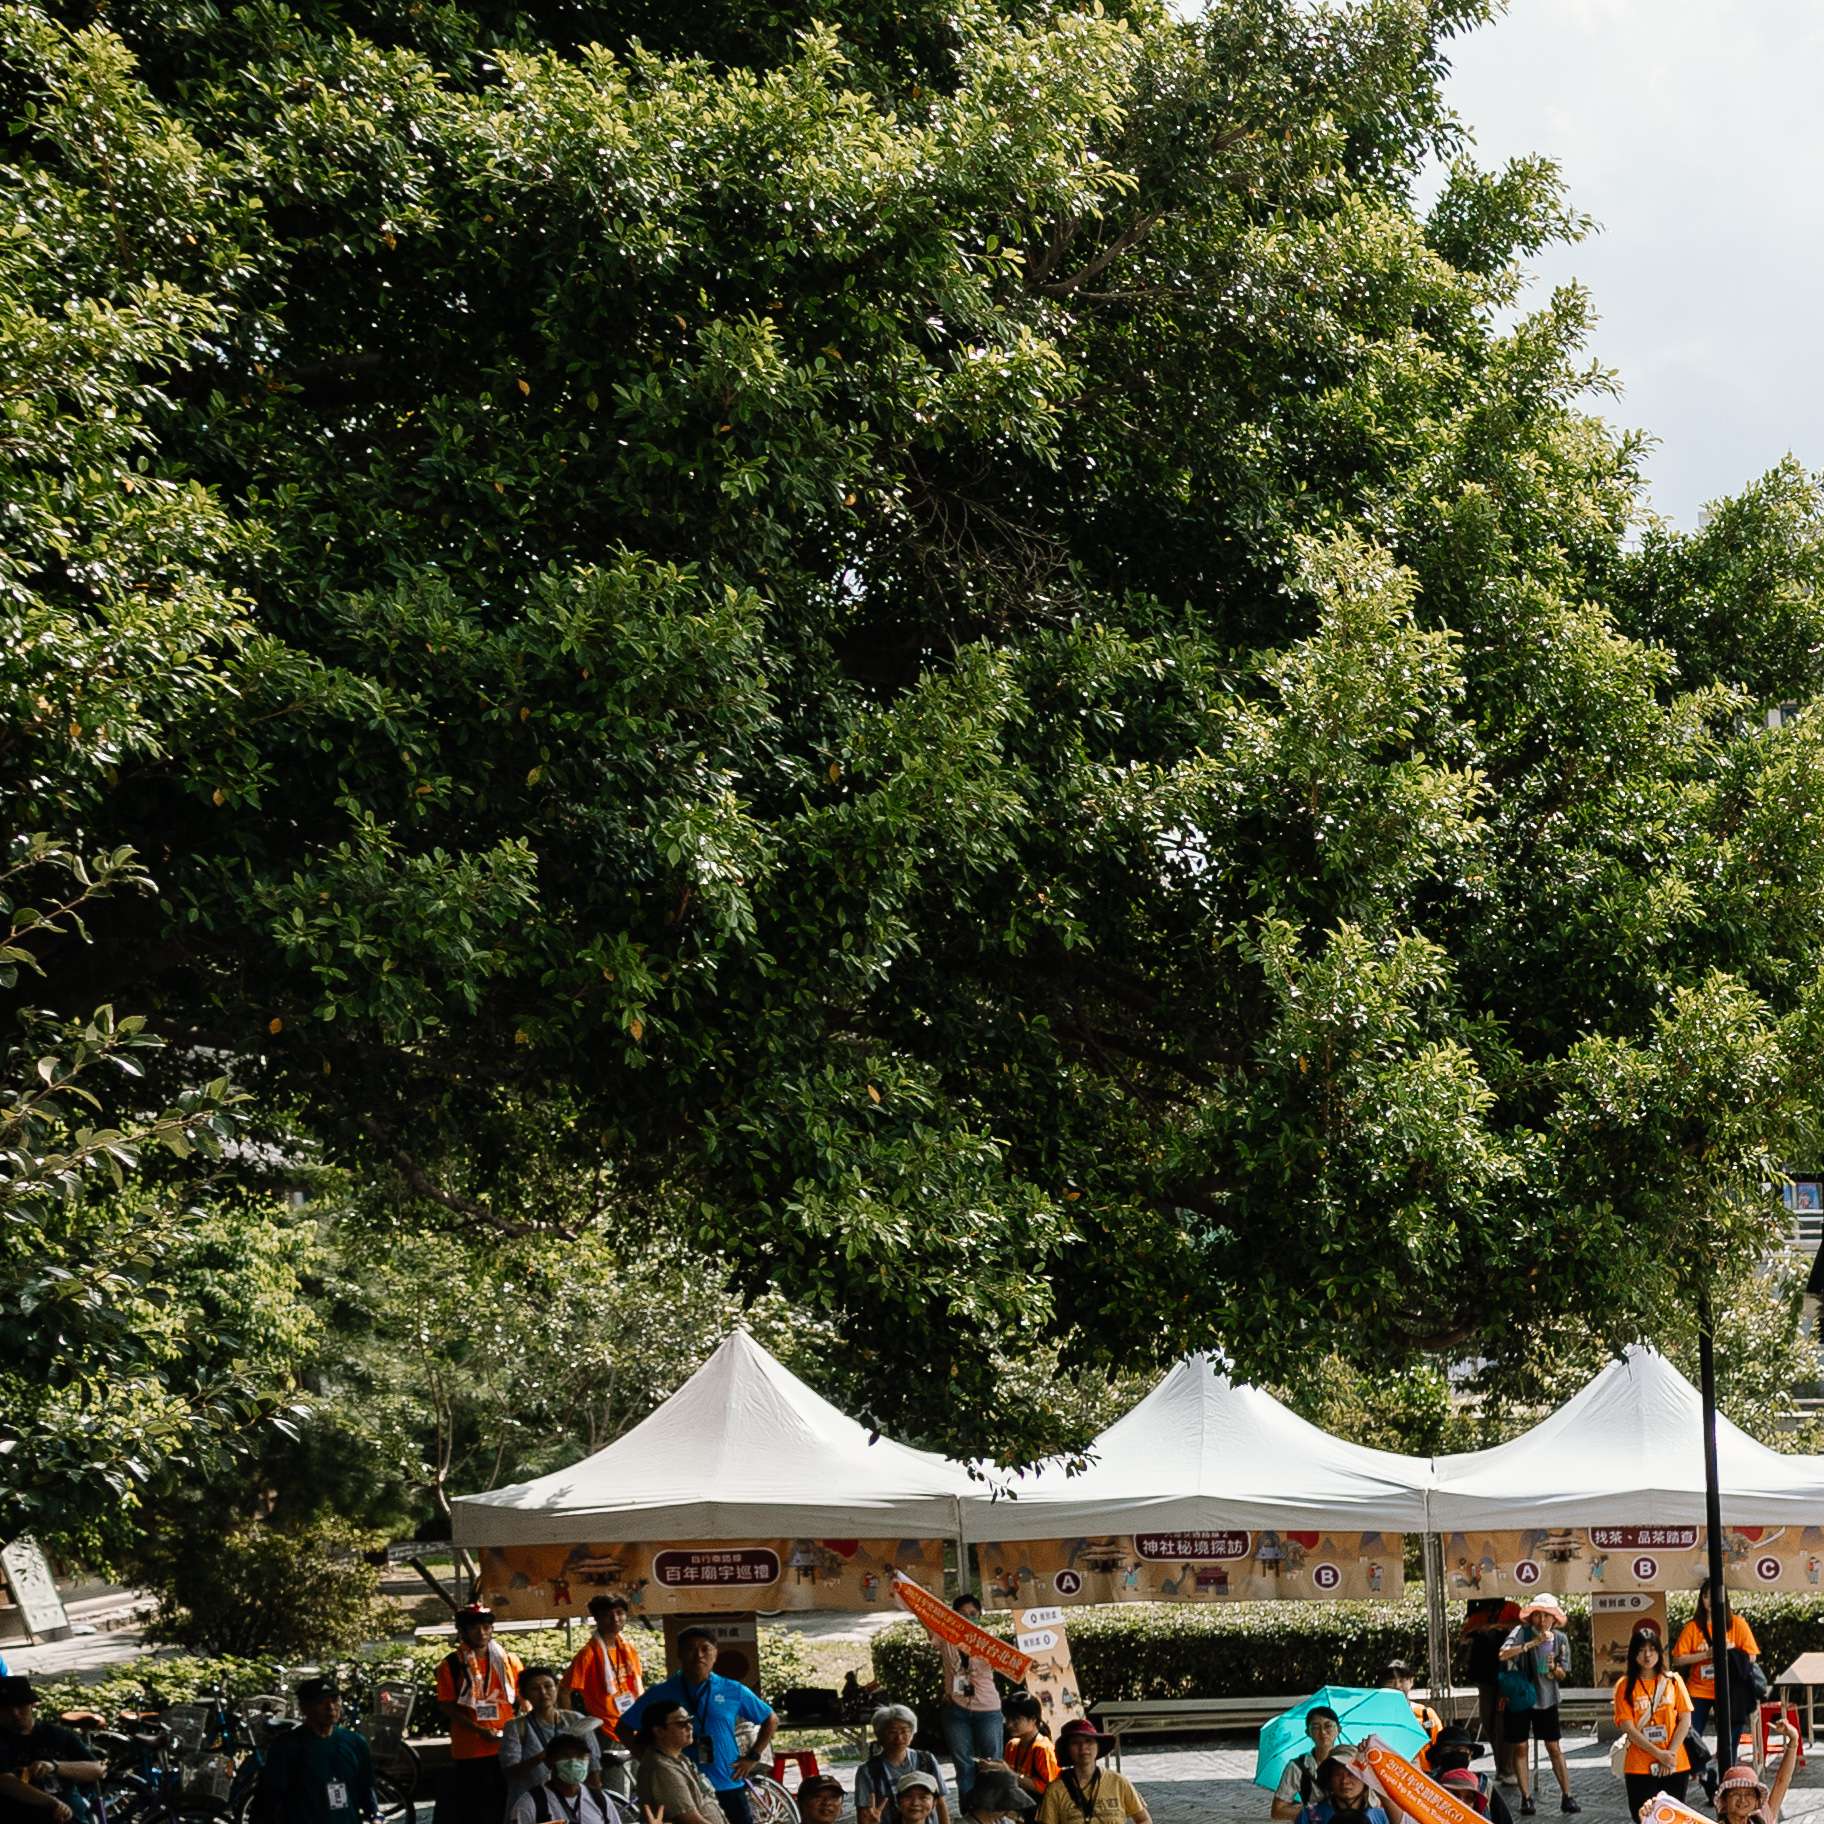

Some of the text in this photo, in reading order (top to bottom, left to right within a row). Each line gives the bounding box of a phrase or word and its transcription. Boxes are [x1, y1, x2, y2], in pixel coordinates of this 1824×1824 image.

[1594, 1529, 1695, 1545] 找茶、品茶踏查
[1143, 1539, 1243, 1556] 神社秘境探訪
[665, 1565, 770, 1581] 百年廟宇巡禮
[1521, 1567, 1534, 1579] A
[1639, 1561, 1652, 1576] B
[1761, 1562, 1775, 1576] C
[1062, 1576, 1077, 1590] A
[1321, 1571, 1334, 1583] B
